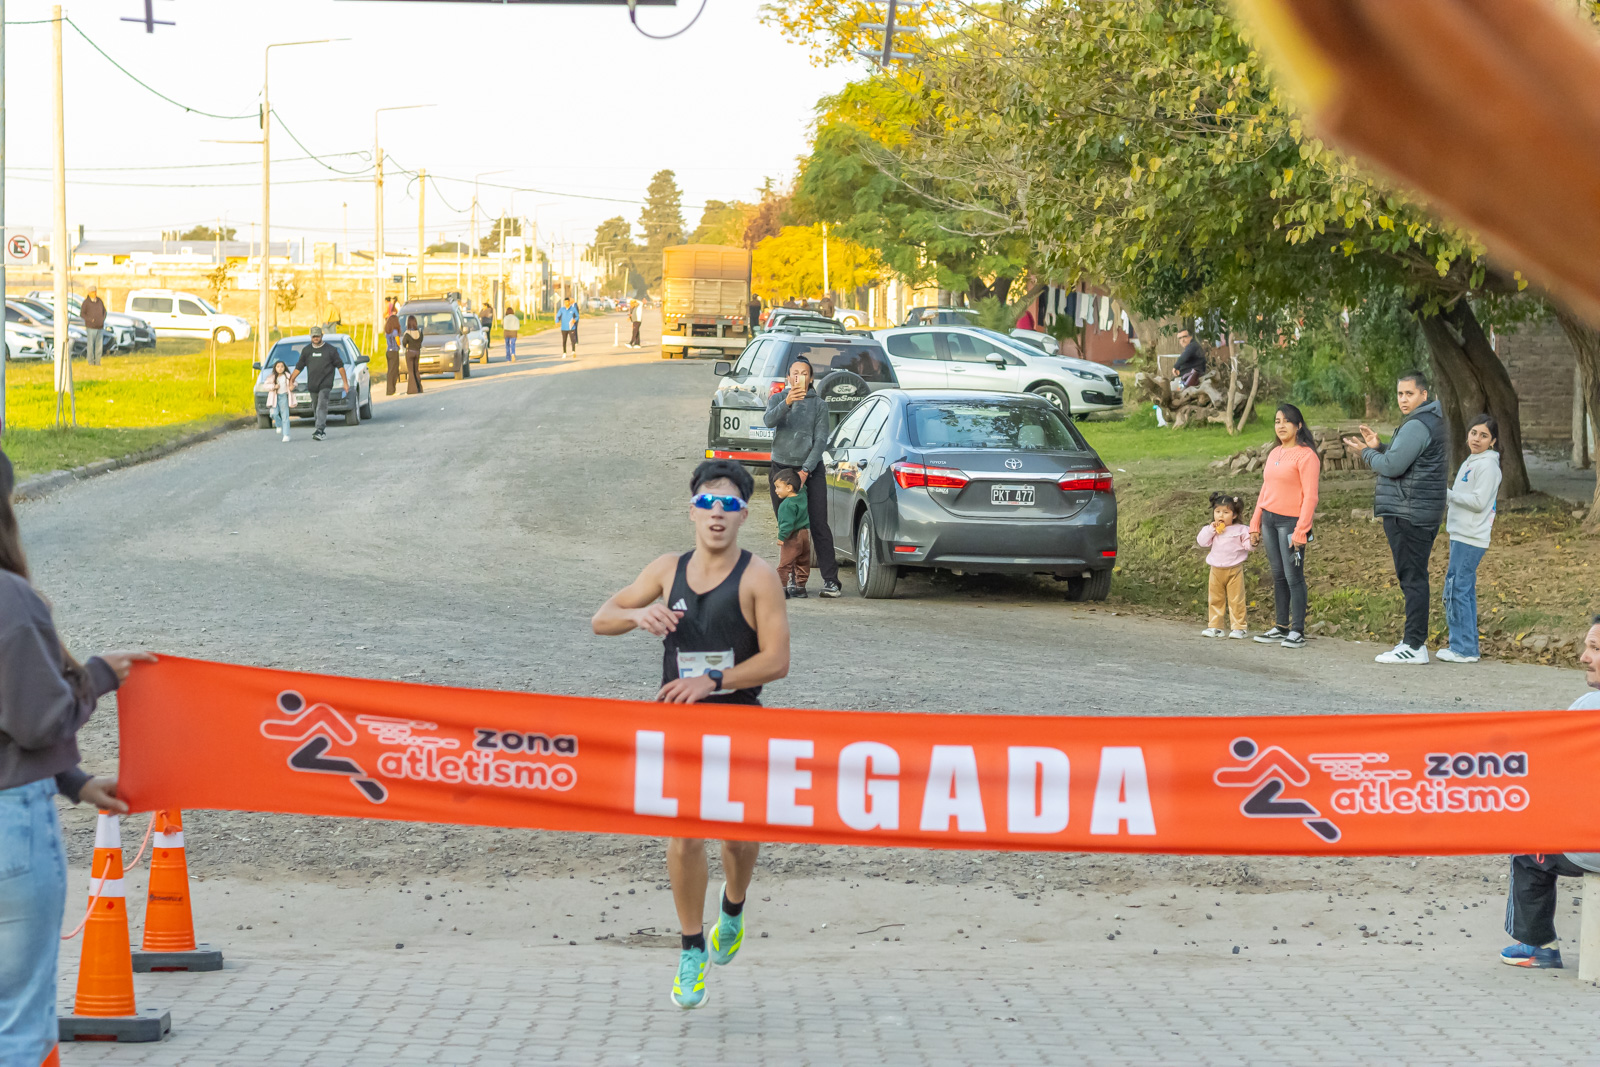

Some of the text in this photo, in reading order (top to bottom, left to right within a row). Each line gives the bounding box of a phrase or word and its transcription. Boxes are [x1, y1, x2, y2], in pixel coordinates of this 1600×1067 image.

[14, 240, 26, 254] E
[723, 416, 740, 430] 80
[993, 490, 1033, 502] PKT 477
[472, 727, 579, 757] zona
[377, 745, 578, 791] atletismo
[1425, 751, 1529, 778] zona
[634, 730, 1157, 836] LLEGADA
[1330, 779, 1530, 815] atletismo
